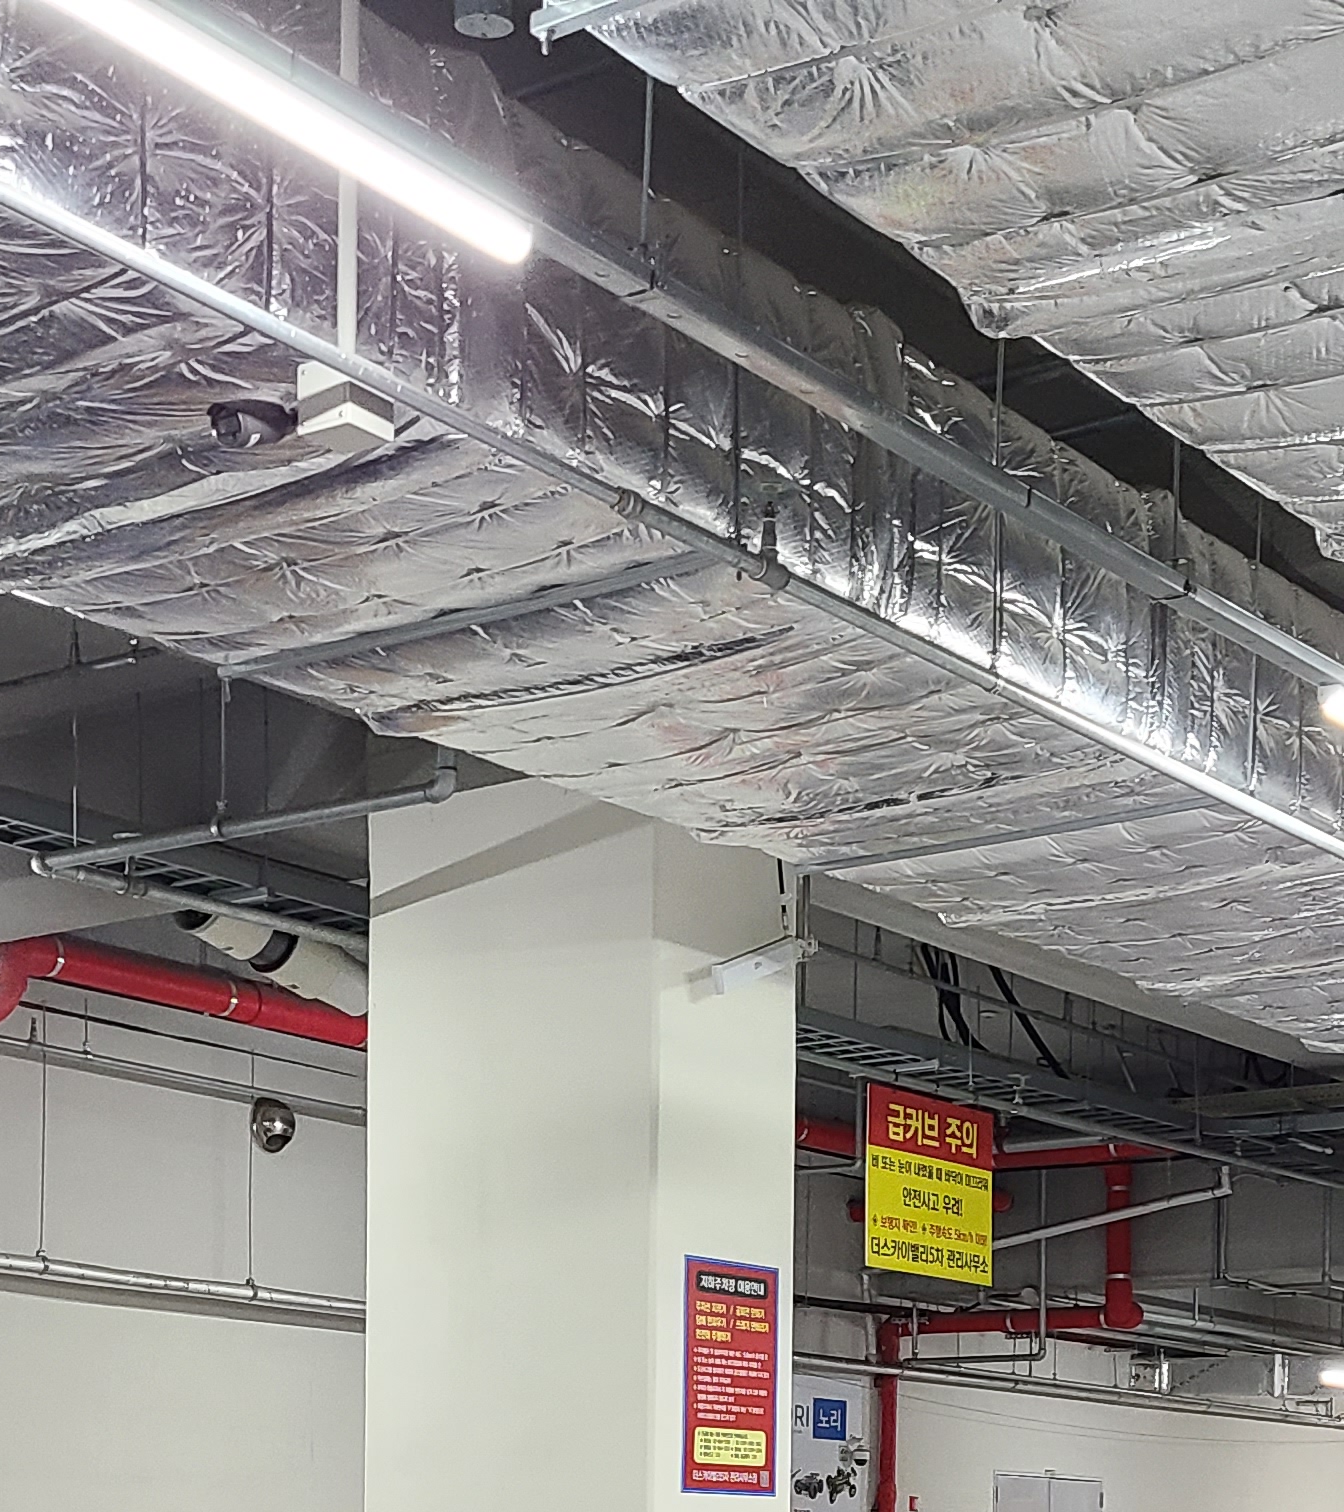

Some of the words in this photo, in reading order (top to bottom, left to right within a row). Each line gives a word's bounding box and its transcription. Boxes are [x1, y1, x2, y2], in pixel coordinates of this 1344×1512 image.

[887, 1103, 940, 1147] 급커브
[945, 1117, 978, 1159] 주의
[902, 1186, 940, 1212] 안전사고
[942, 1194, 963, 1217] 우려!
[871, 1236, 944, 1267] 더스카이밸리5차
[946, 1248, 989, 1274] 관리사무소
[699, 1275, 736, 1292] 지하주차장
[737, 1280, 765, 1296] 이용안내
[791, 1404, 809, 1427] RI
[817, 1408, 841, 1431] 노리
